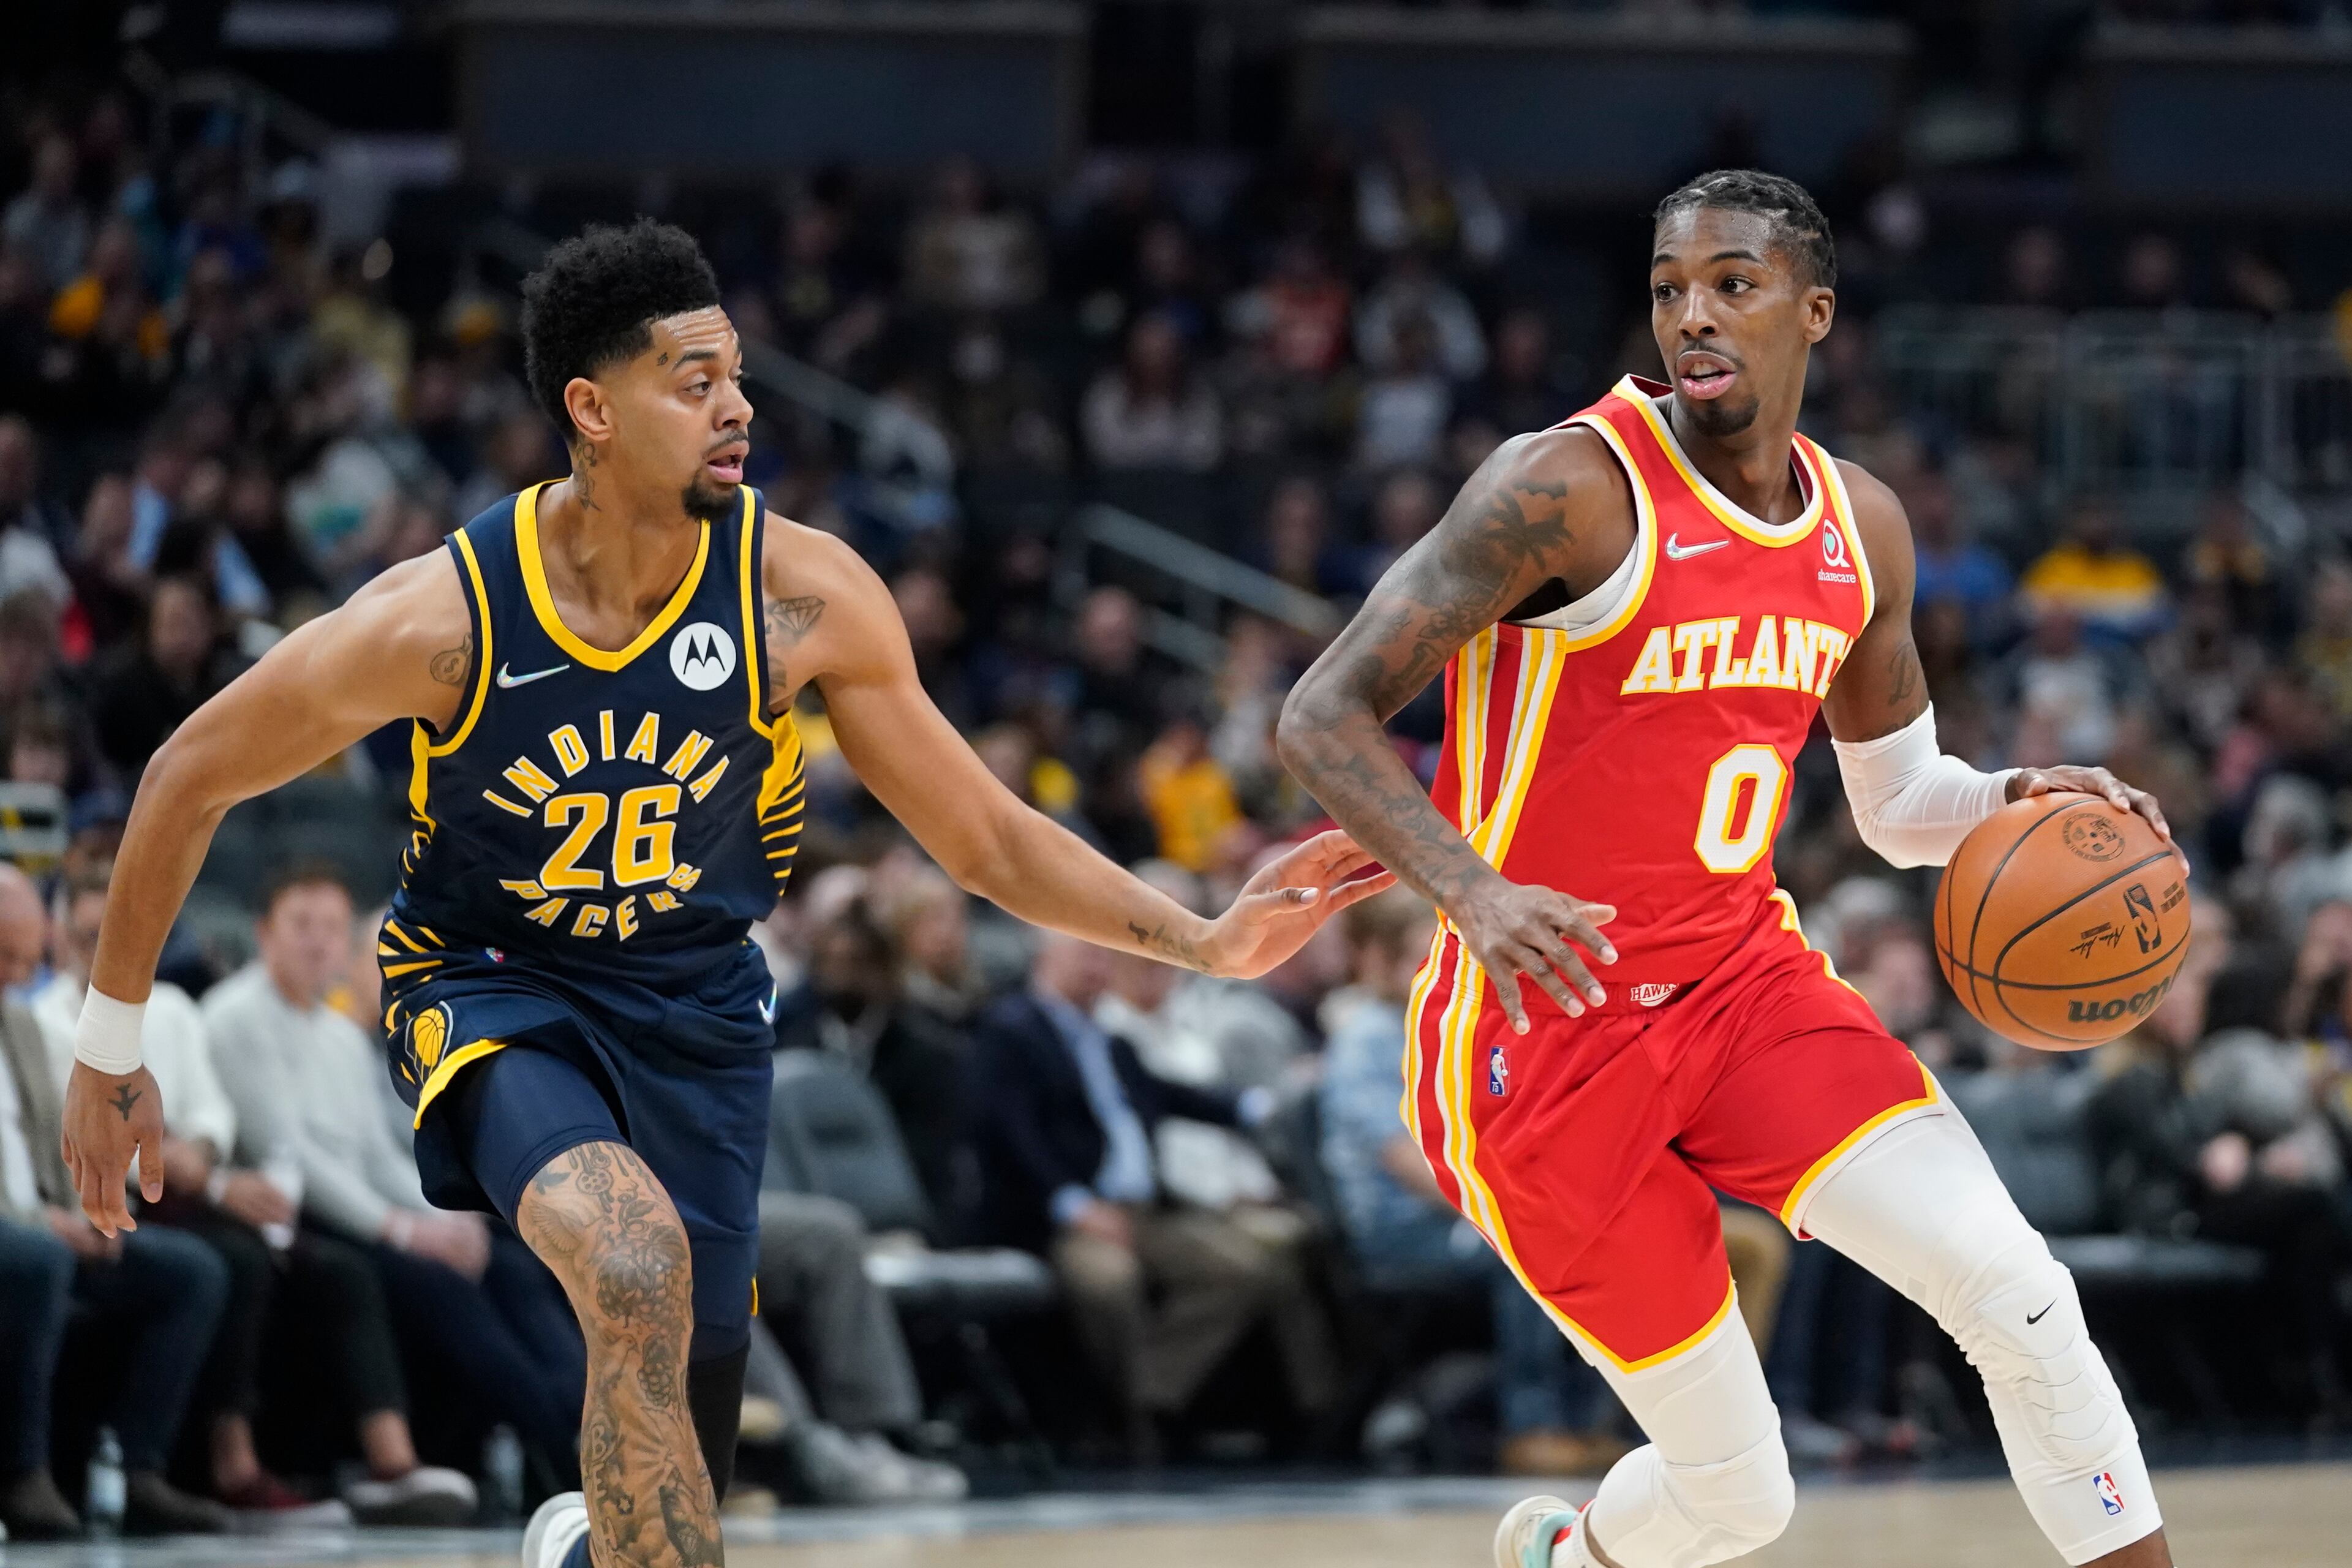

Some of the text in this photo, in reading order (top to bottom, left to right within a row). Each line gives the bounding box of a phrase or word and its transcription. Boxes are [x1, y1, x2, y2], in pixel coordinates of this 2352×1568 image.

[1817, 568, 1856, 584] sharecare
[483, 709, 730, 818] INDIANA
[1694, 743, 1789, 874] 0
[540, 783, 682, 890] 26
[499, 862, 703, 941] PACERS
[2067, 965, 2182, 1022] ilson
